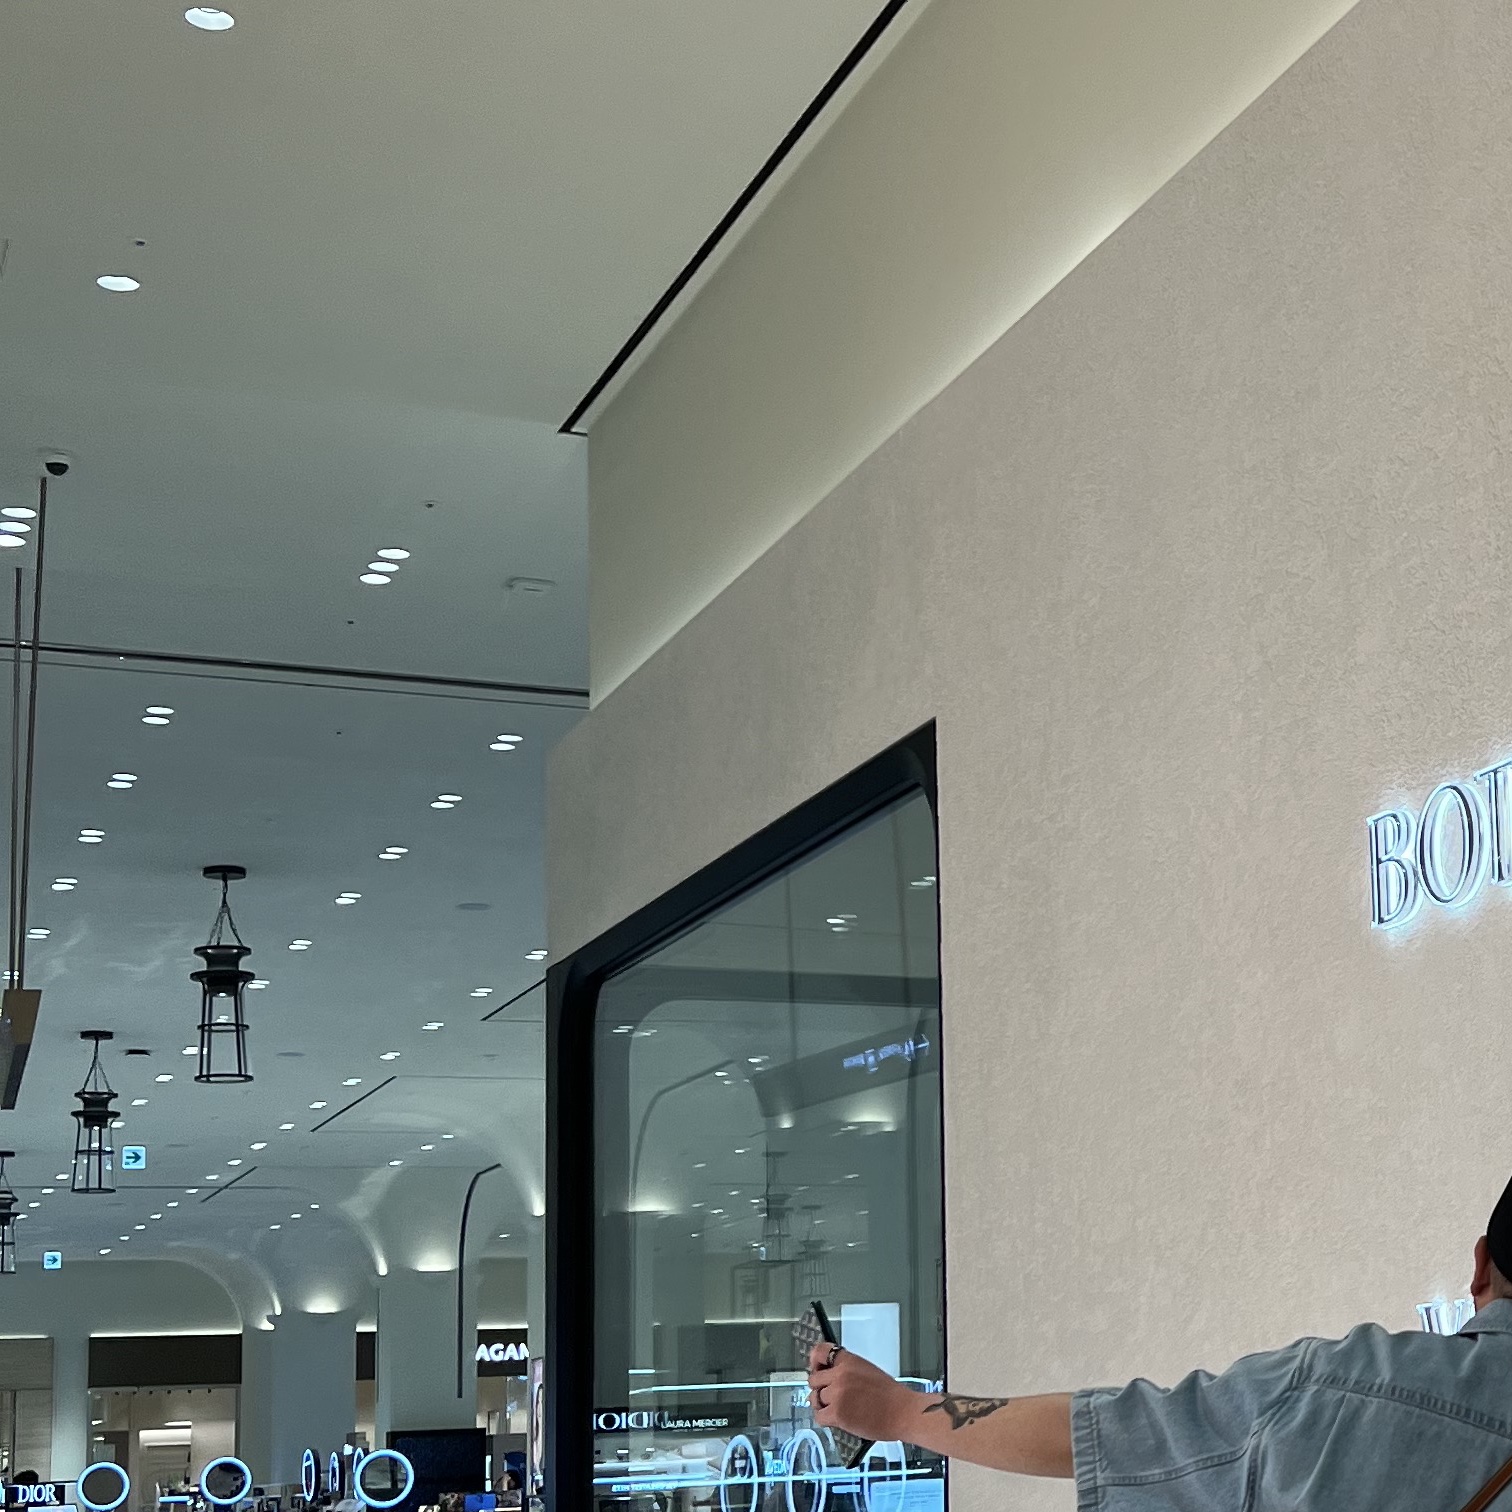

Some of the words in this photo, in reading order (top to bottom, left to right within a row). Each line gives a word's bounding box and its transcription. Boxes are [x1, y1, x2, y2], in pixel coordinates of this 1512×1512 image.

[661, 1419, 691, 1429] LAURA
[692, 1417, 729, 1428] MERCIER
[18, 1484, 56, 1503] DIOR
